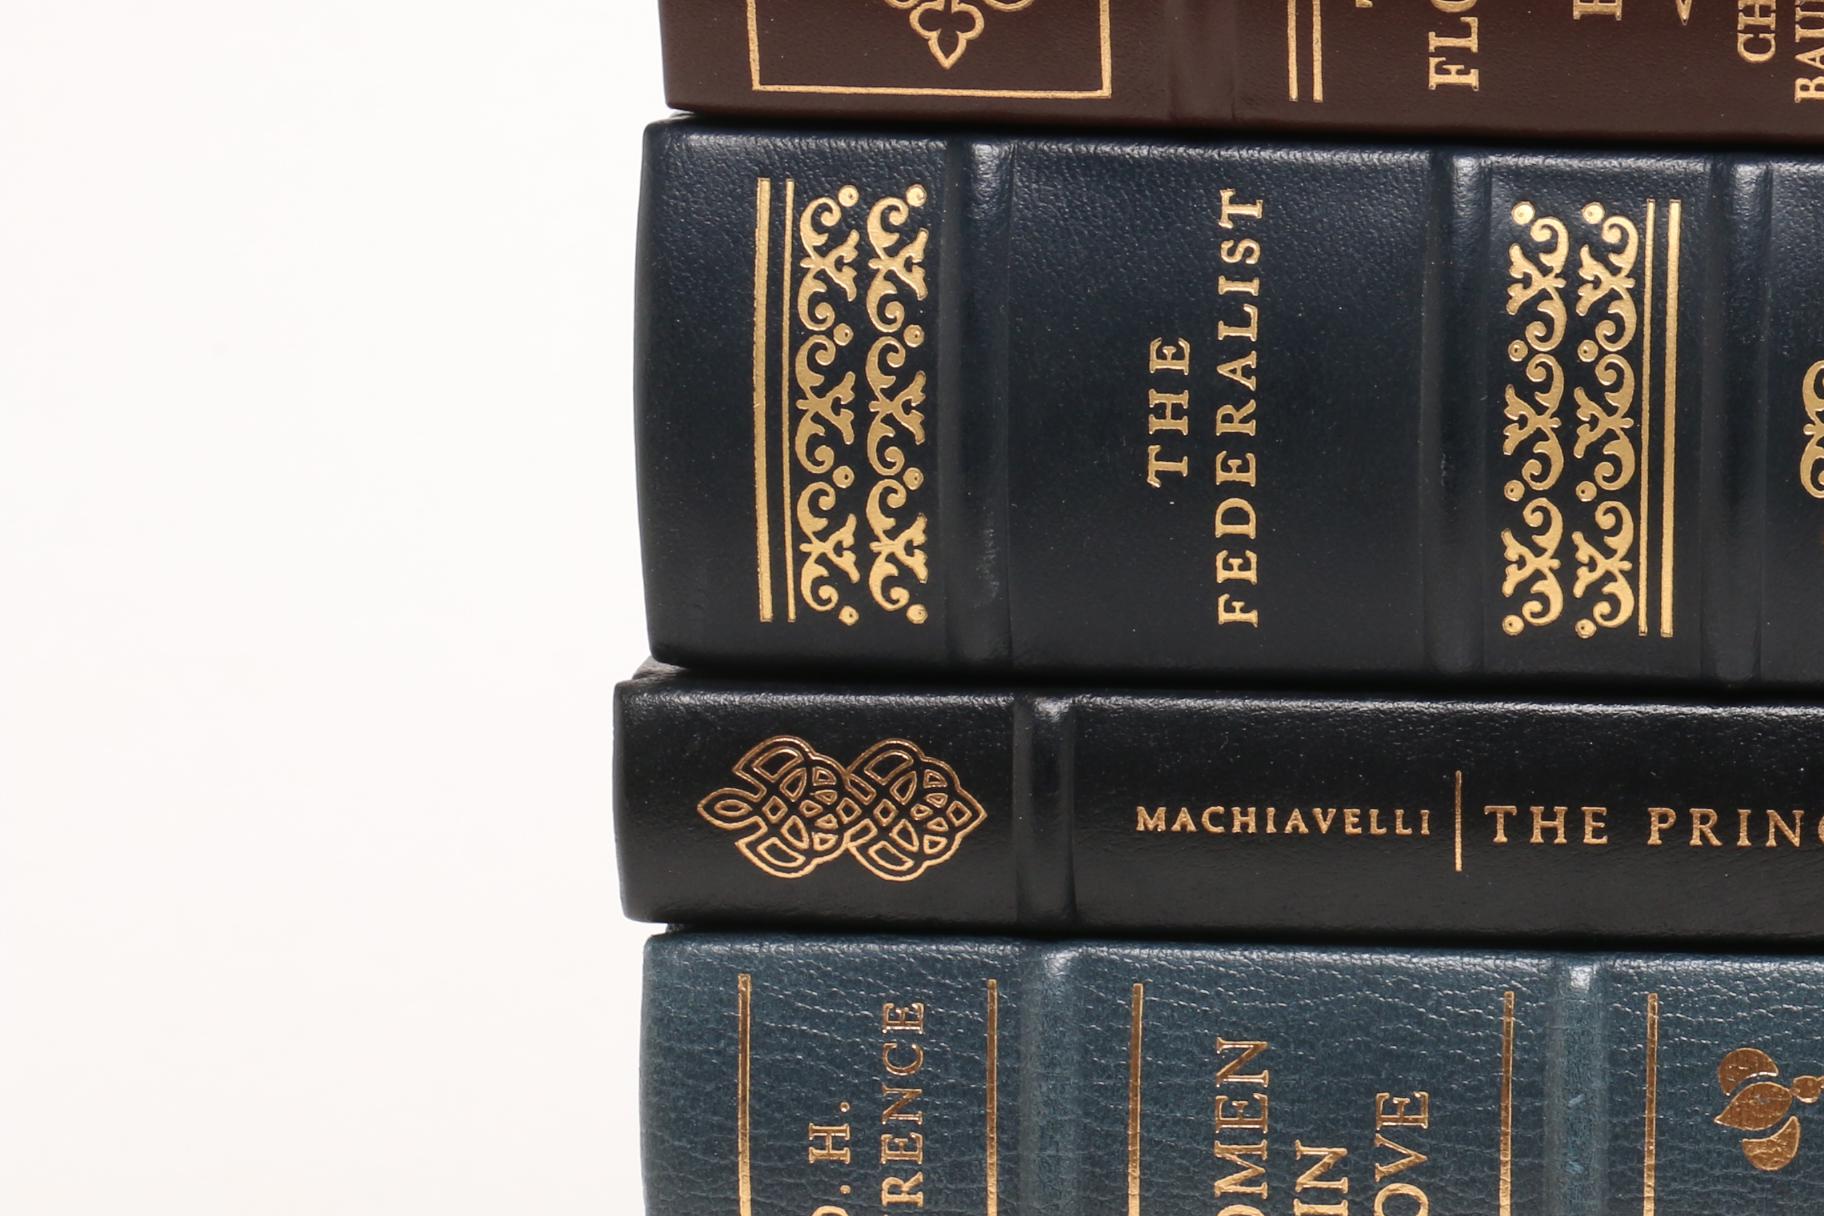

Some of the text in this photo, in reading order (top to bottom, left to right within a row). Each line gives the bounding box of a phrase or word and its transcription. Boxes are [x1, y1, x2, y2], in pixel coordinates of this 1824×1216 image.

[1146, 337, 1191, 488] THE
[1214, 188, 1263, 627] FEDERALIST
[1135, 805, 1431, 836] MACHIAVELLI
[1483, 805, 1609, 845] THE
[807, 1100, 852, 1165] H.
